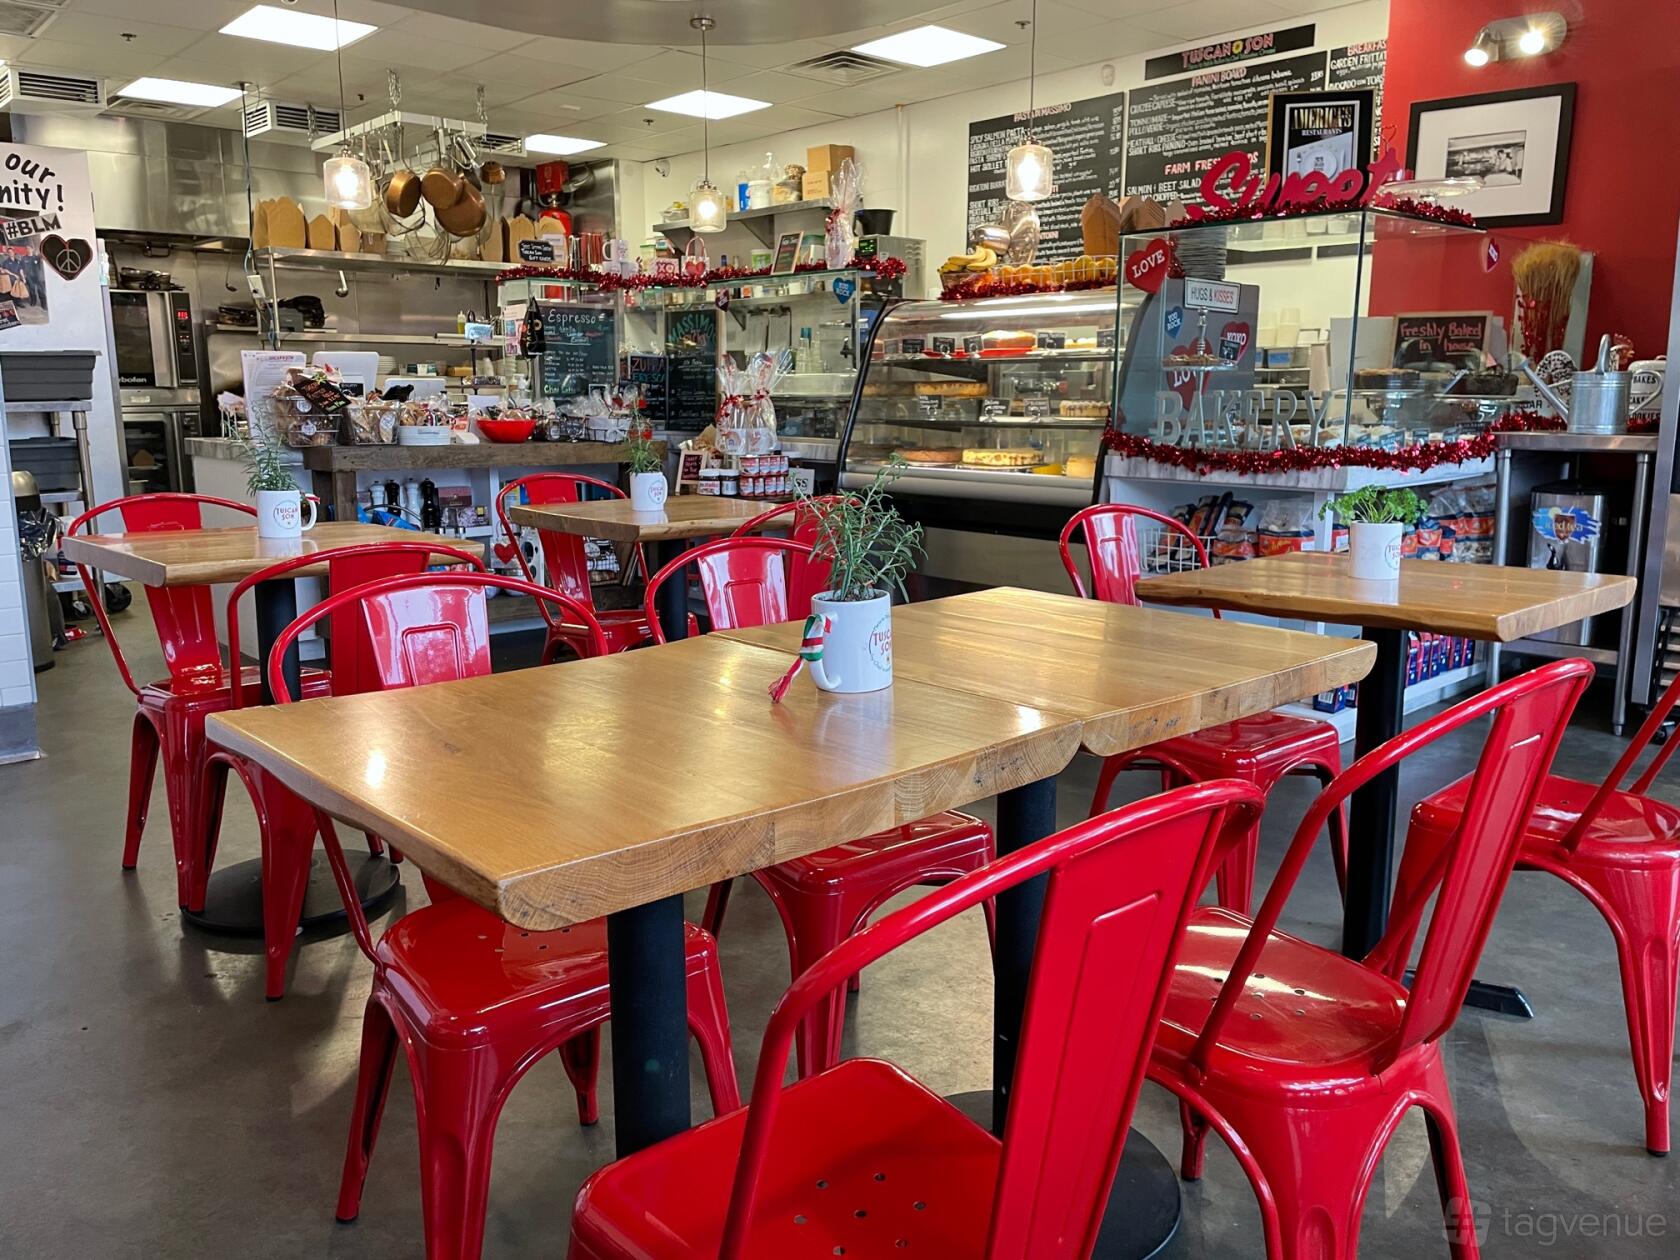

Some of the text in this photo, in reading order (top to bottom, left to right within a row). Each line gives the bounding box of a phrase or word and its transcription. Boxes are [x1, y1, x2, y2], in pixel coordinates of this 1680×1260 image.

[1244, 34, 1274, 54] SON
[1331, 56, 1359, 70] GARDEN
[1191, 71, 1220, 87] PANINI
[1220, 67, 1247, 82] BOARD
[1293, 106, 1352, 129] AMERICA'S
[5, 153, 55, 183] our
[1165, 161, 1191, 175] FARM
[1127, 184, 1152, 197] SALMON
[1158, 181, 1176, 192] BEET
[6, 213, 61, 239] #BLM
[1131, 249, 1165, 278] LOVE
[1191, 287, 1208, 301] HUGS
[1214, 291, 1234, 304] KISSES
[548, 308, 596, 327] Espresso
[1167, 311, 1178, 321] YOU
[1167, 318, 1181, 331] ROCK
[1401, 322, 1482, 344] Freshly Baked
[1444, 339, 1475, 351] house
[1152, 389, 1332, 451] BAKERY
[281, 513, 294, 521] SON
